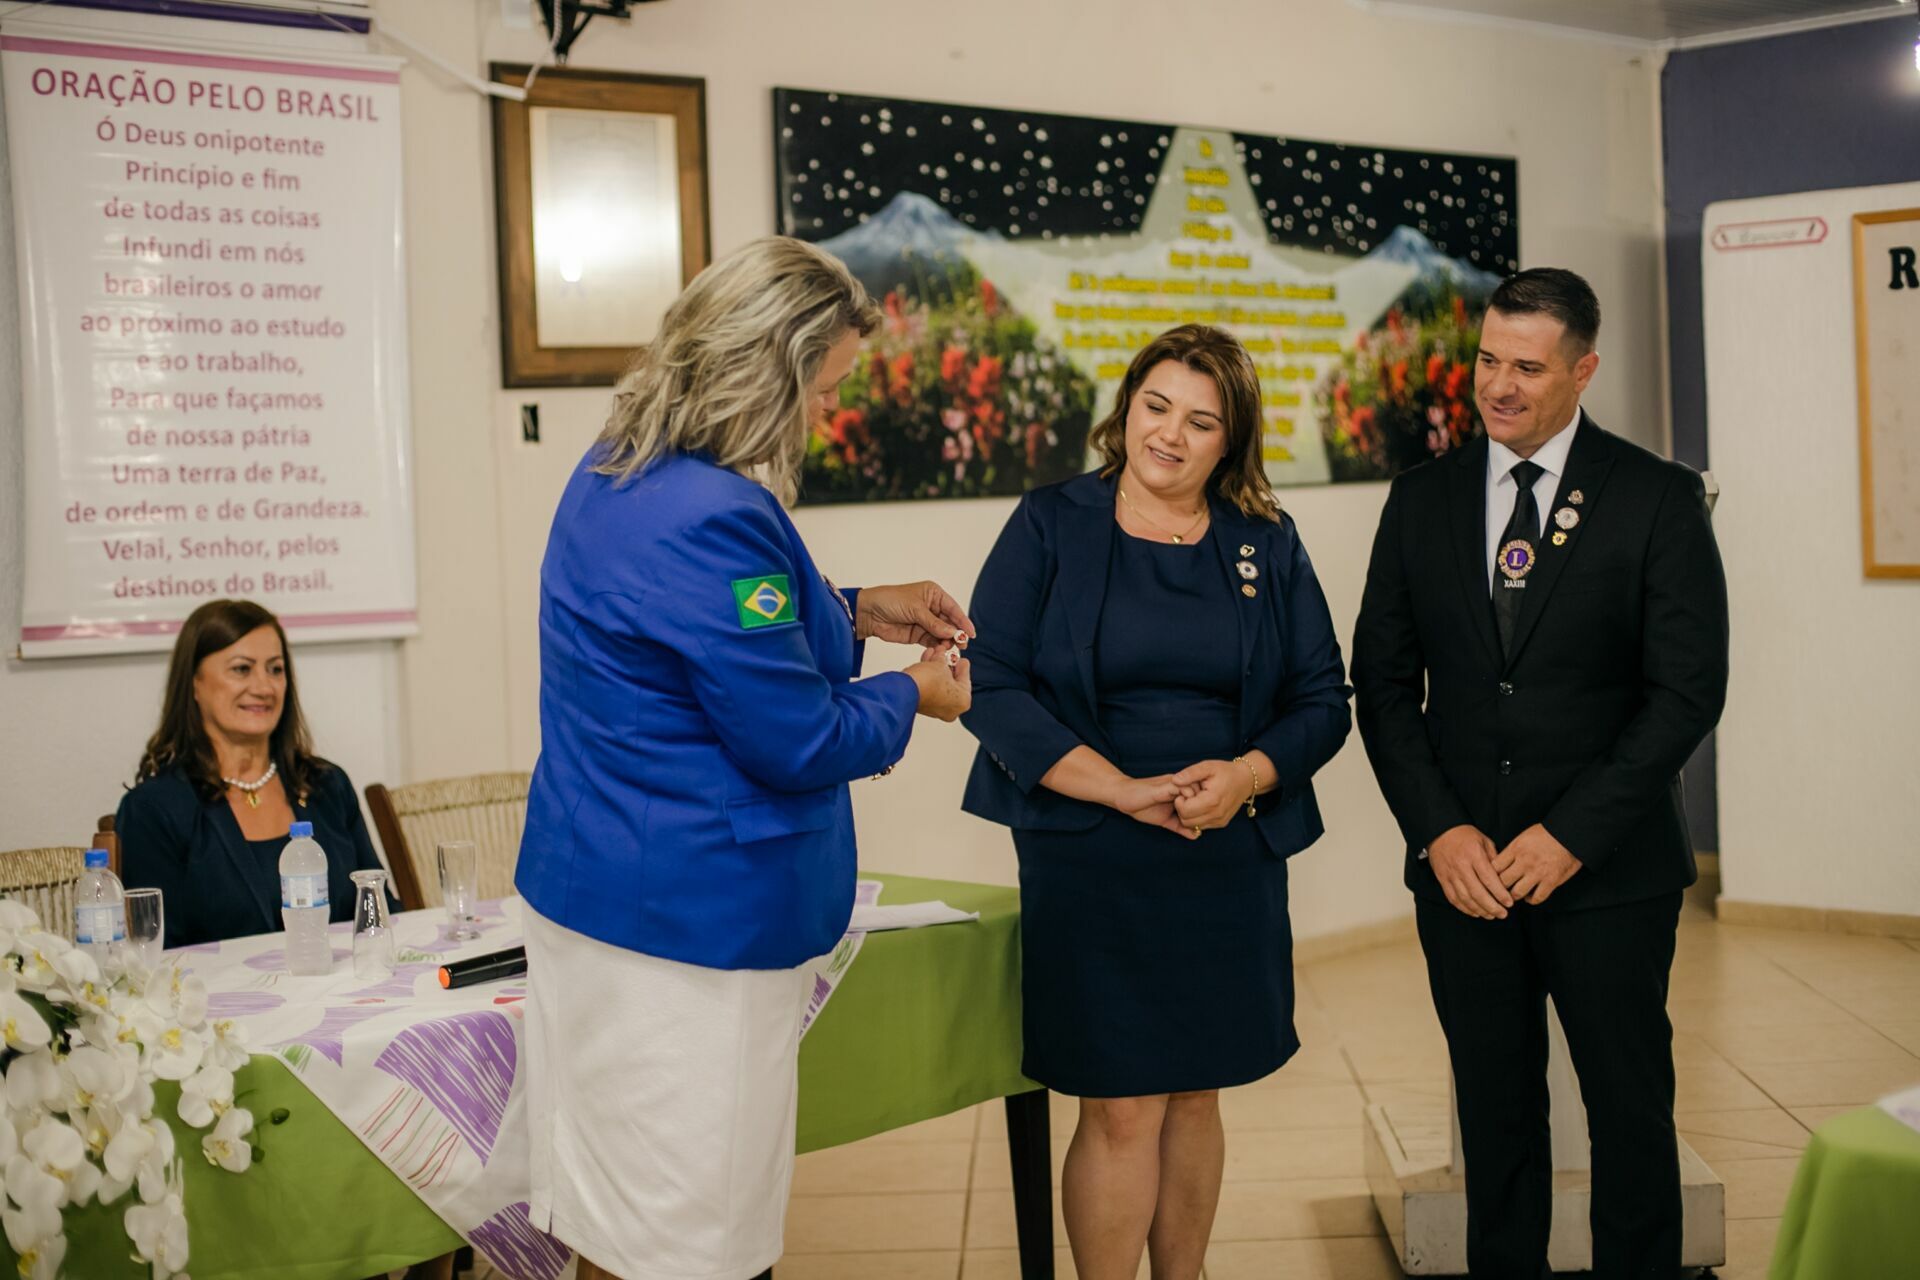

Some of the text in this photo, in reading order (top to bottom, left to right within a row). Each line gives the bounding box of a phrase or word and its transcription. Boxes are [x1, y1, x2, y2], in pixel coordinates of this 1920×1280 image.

[32, 67, 379, 122] ORAÇÃO PELO BRASIL
[96, 115, 325, 158] Ó Deus onipotente
[124, 160, 301, 191] Princípio e fim
[103, 196, 320, 229] de todas as coisas
[122, 236, 304, 264] Infundi em nós
[104, 272, 322, 301] brasileiros o amor
[80, 313, 346, 338] ao próximo ao estudo
[136, 352, 304, 375] e ao trabalho,
[111, 386, 324, 414] Para que façamos
[127, 424, 312, 449] de nossa pátria
[112, 461, 326, 486] Uma terra de Paz,
[65, 501, 98, 524] de
[104, 501, 187, 523] ordem
[196, 505, 208, 521] e
[216, 501, 245, 520] de
[102, 535, 339, 561] Velai, Senhor, pelos
[1510, 551, 1523, 567] L
[113, 570, 333, 599] destinos do Brasil.
